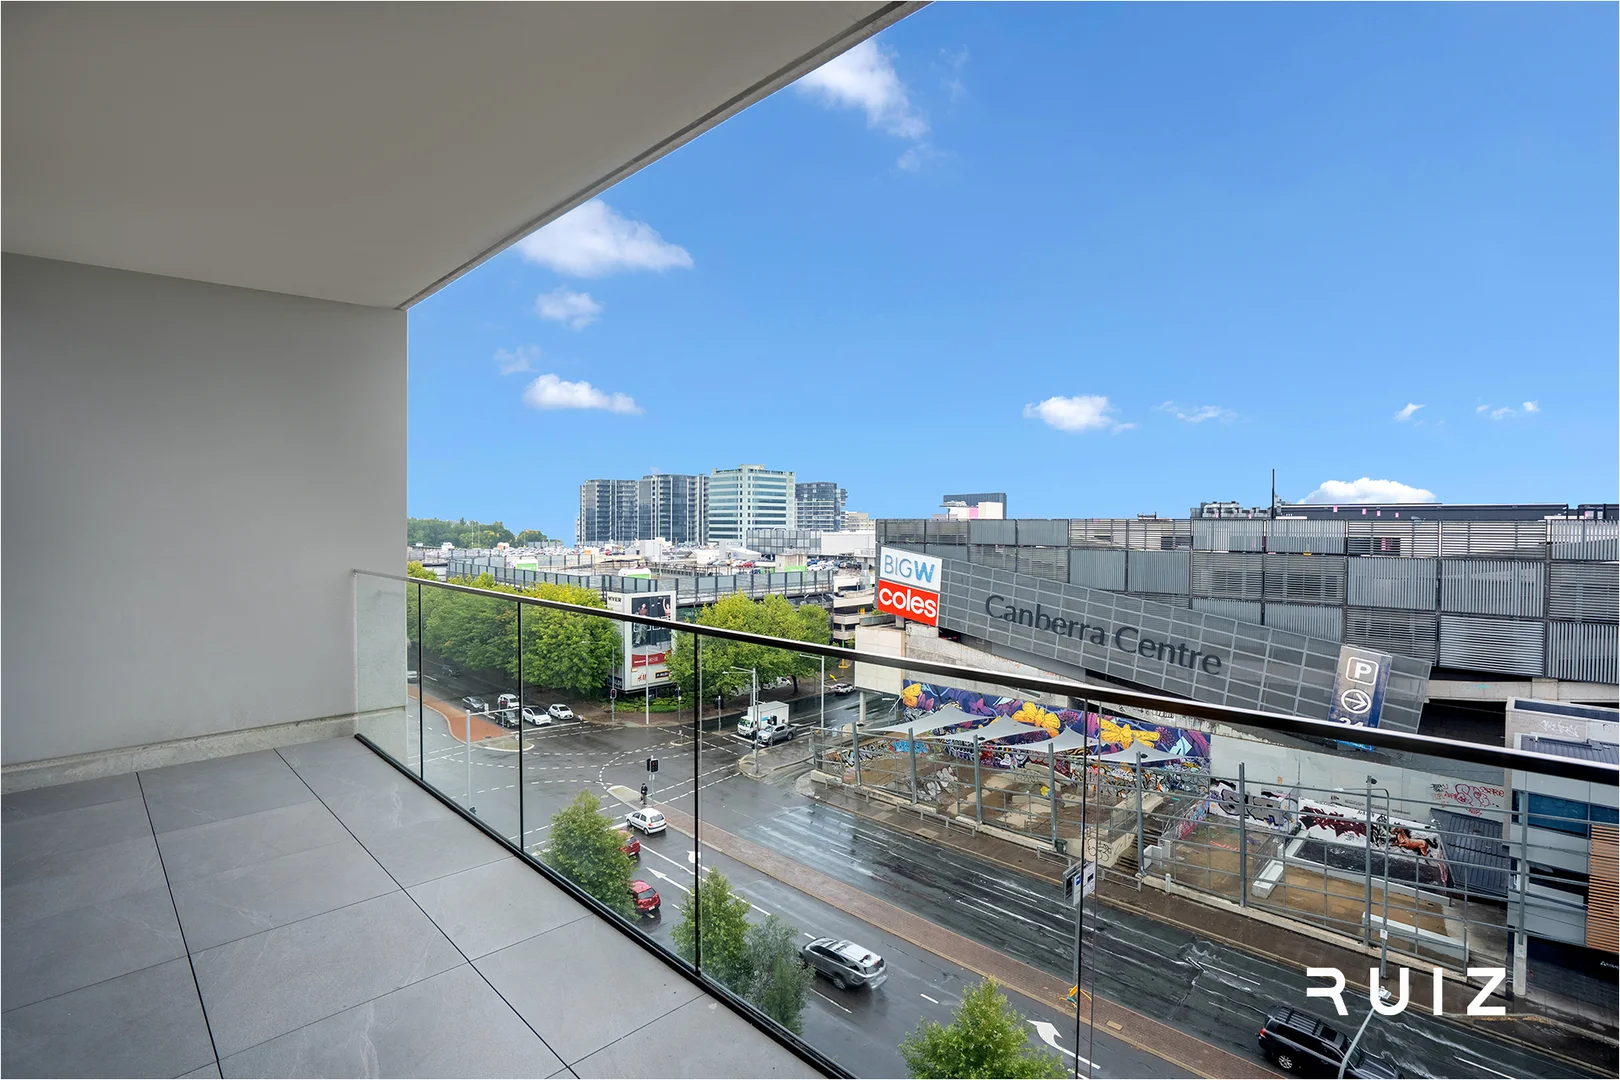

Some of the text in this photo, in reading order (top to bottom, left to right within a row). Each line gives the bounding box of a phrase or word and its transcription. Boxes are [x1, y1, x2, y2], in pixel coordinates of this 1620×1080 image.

[878, 588, 937, 619] coles
[985, 594, 1223, 676] Canberra Centre
[1354, 662, 1373, 680] P
